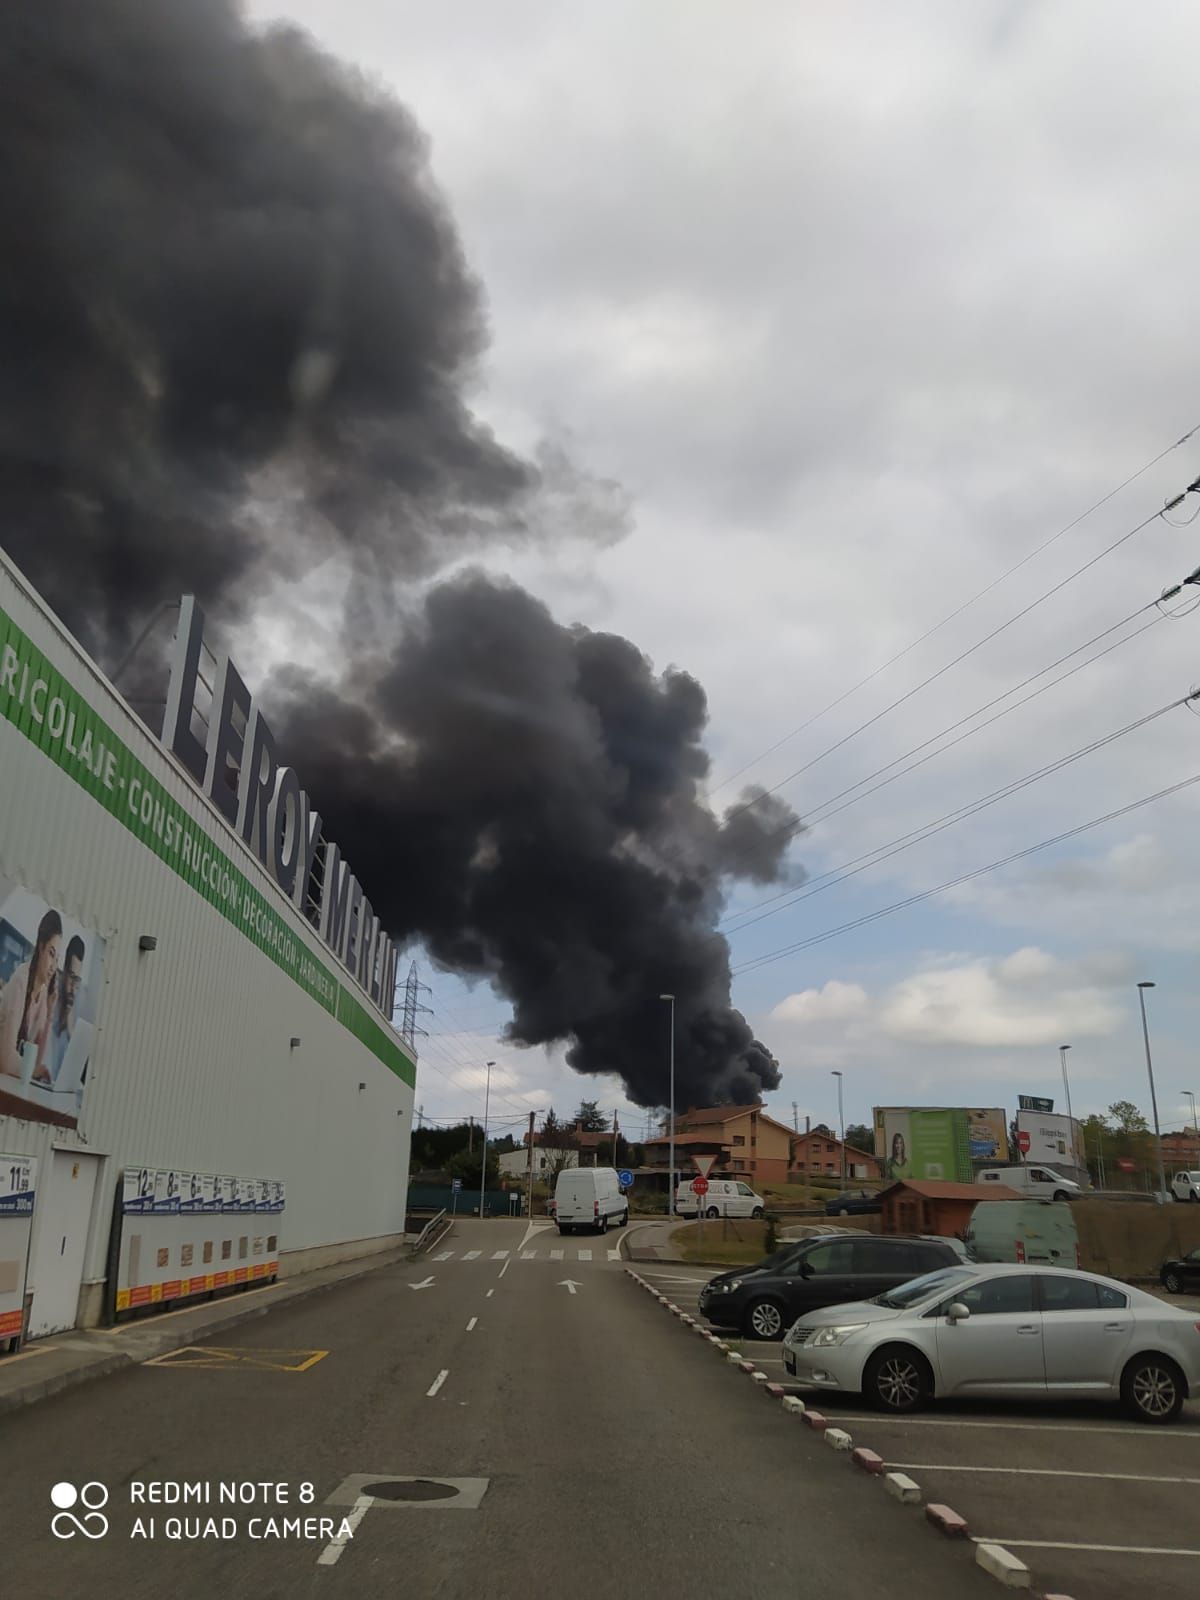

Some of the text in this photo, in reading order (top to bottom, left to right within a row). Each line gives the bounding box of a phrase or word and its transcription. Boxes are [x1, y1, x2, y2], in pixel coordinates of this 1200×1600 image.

[128, 779, 239, 909] CONSTRUCCIÓN
[242, 897, 297, 967] DECORACIÓN
[299, 954, 334, 1005] JARDINERA
[161, 594, 398, 1021] LEROY MERLIN
